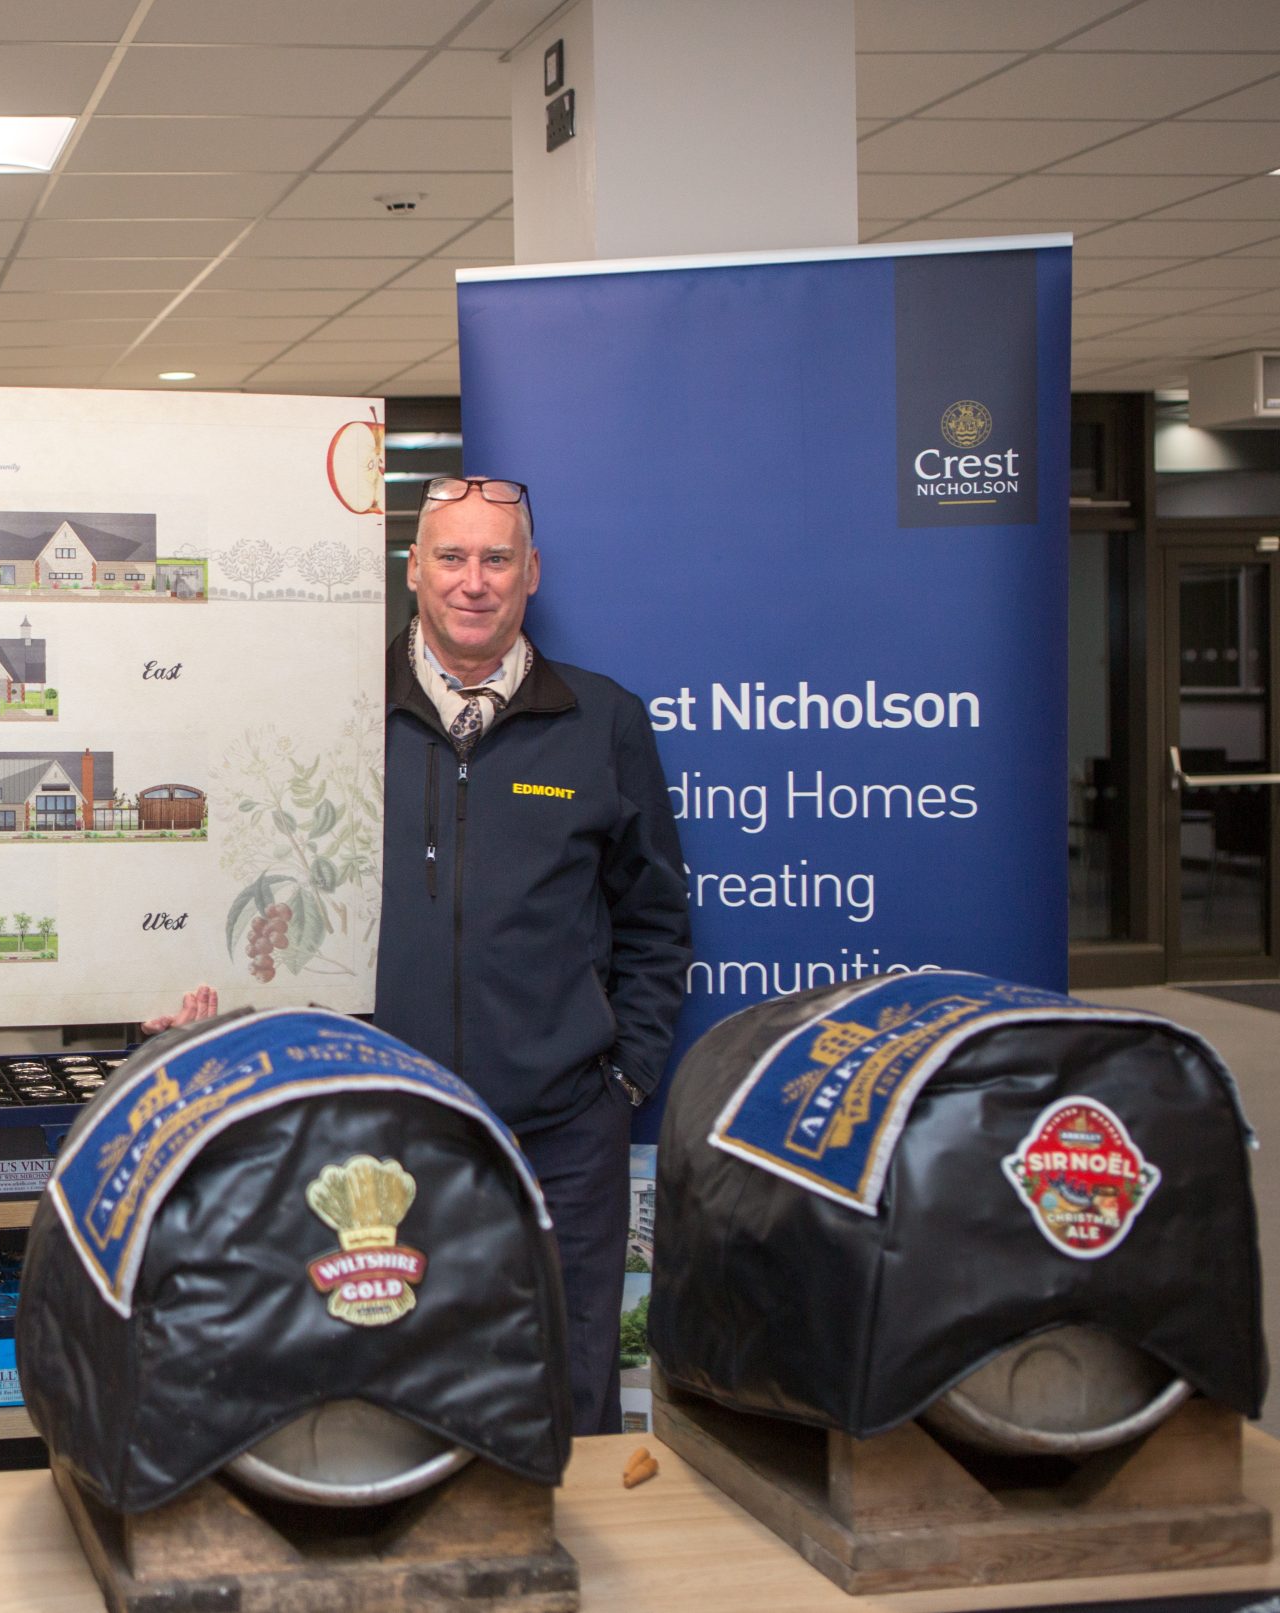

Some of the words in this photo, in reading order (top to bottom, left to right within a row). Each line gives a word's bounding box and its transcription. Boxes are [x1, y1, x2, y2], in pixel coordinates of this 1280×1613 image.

[914, 448, 1019, 480] Crest
[917, 481, 1018, 497] NICHOLSON
[142, 660, 183, 680] East
[712, 680, 980, 731] Nicholson
[512, 782, 576, 800] EDMONT
[667, 771, 767, 834] ding
[788, 770, 978, 818] Homes
[142, 912, 189, 931] West
[21, 1159, 55, 1172] VINT
[1028, 1152, 1069, 1172] SIR
[1071, 1152, 1135, 1179] NOËL
[1047, 1212, 1120, 1228] CHRISTMAS
[1066, 1225, 1101, 1240] ALE
[319, 1252, 420, 1280] WILTSHIRE
[341, 1279, 403, 1300] GOLD
